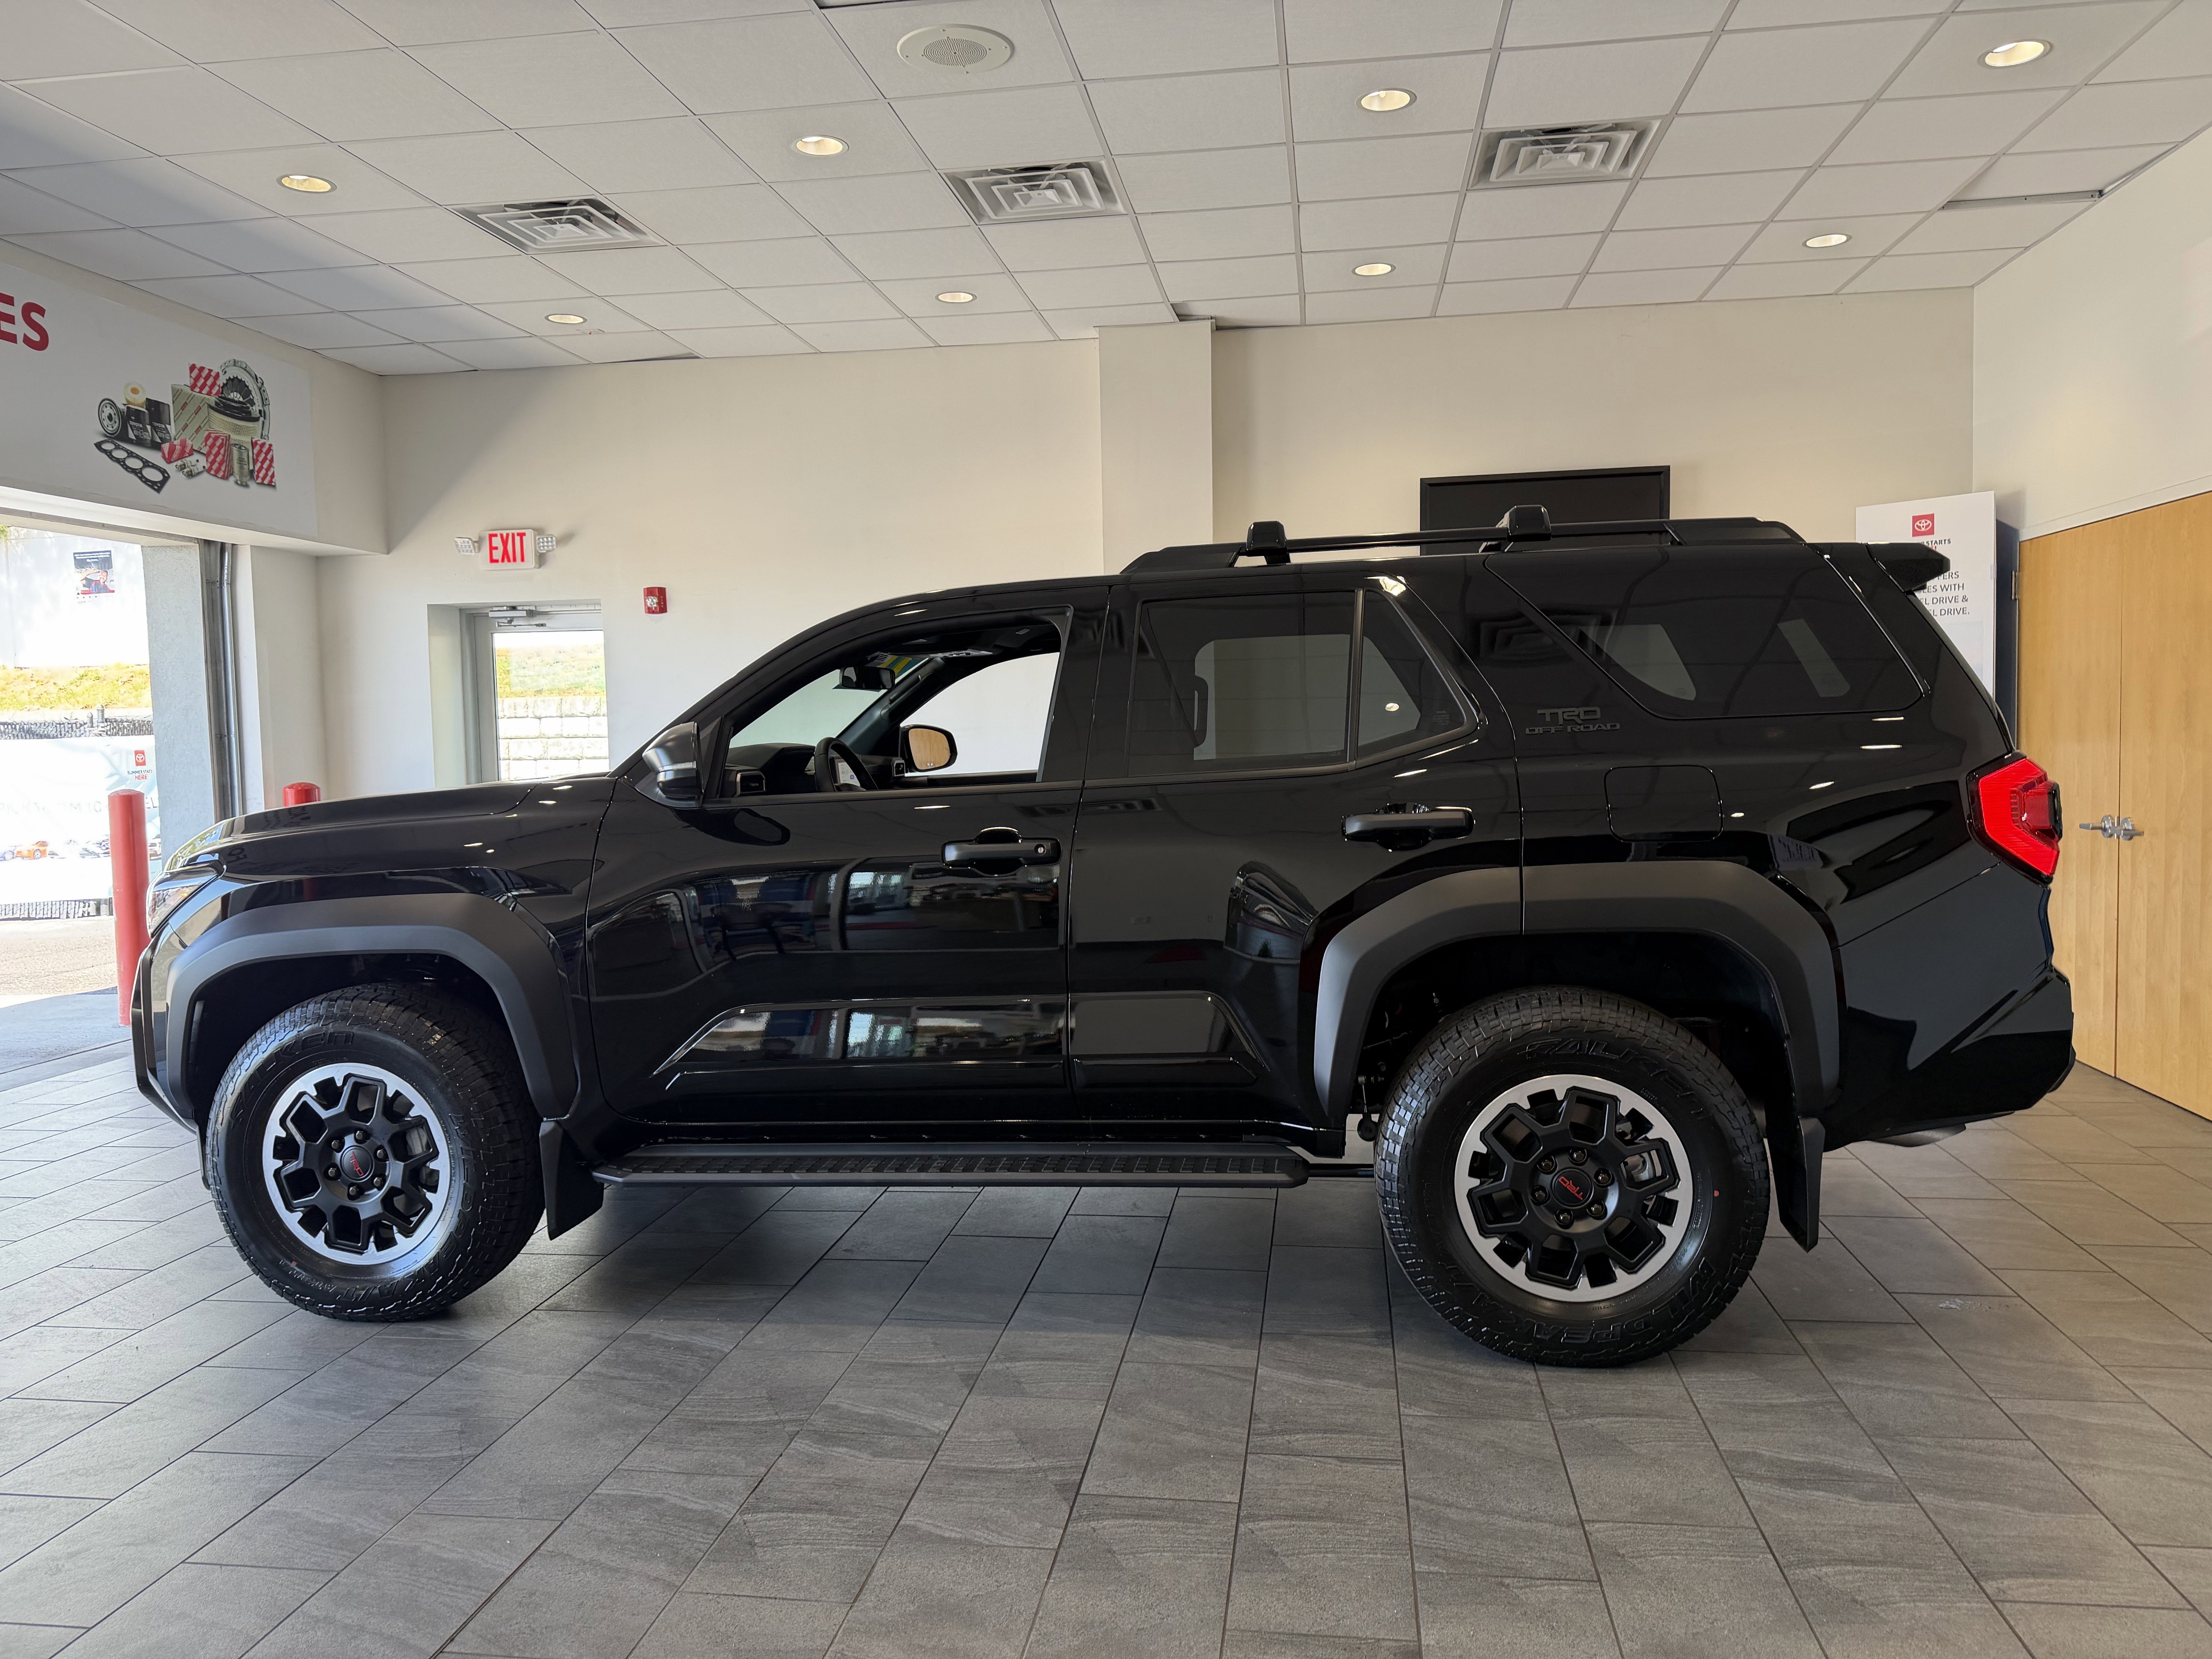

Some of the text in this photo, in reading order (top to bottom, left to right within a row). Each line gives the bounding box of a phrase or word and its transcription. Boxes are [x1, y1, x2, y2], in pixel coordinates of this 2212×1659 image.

[488, 532, 526, 563] EXIT
[1940, 583, 1964, 592] WITH
[1932, 595, 1959, 605] DRIVE
[1940, 607, 1970, 616] DRIVE.
[1537, 707, 1601, 725] TRD
[1525, 723, 1621, 735] OFF ROAD
[231, 1030, 354, 1126] FALKEN
[350, 1151, 364, 1176] TRD
[1559, 1176, 1583, 1200] TRD
